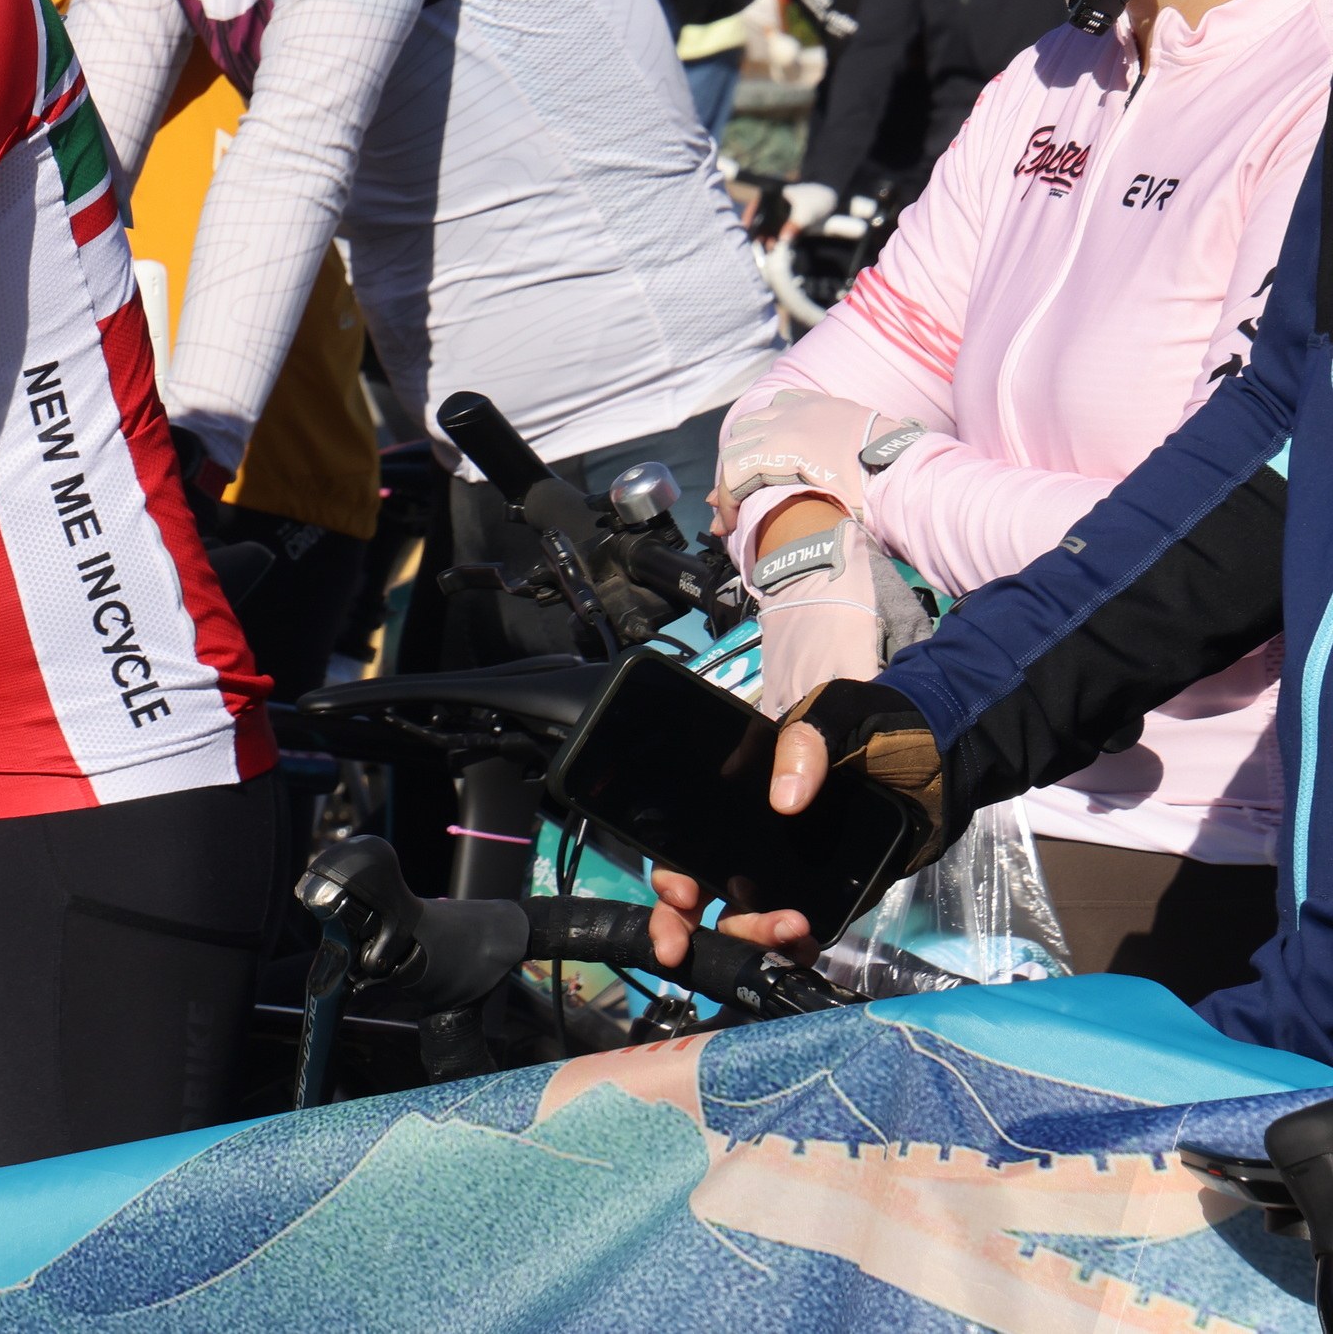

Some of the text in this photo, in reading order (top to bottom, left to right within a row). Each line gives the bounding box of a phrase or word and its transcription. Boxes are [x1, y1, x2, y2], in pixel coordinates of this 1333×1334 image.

[1122, 173, 1181, 211] EVR
[22, 359, 173, 730] NEW ME INCYCLE
